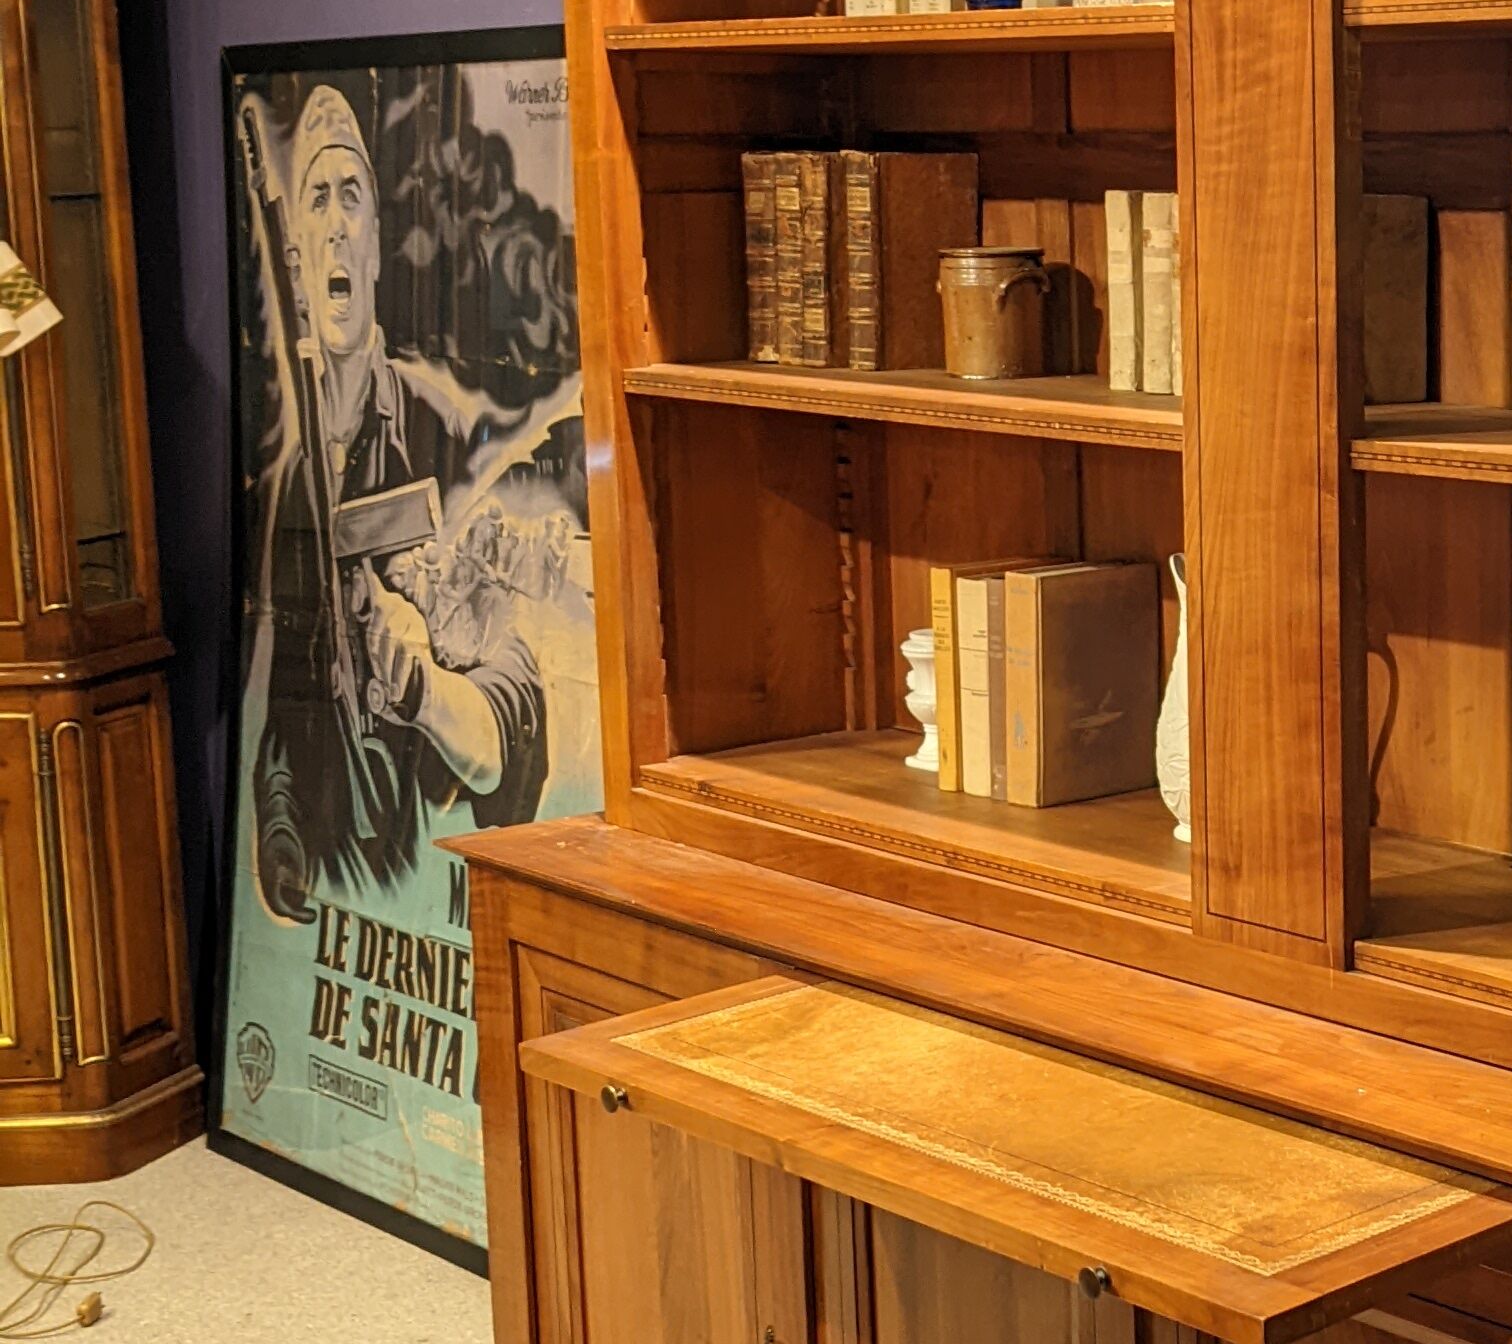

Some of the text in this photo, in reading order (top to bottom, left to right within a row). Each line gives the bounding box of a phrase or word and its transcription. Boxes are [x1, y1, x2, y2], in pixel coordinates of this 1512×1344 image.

[314, 903, 477, 1022] LE DERNIE
[309, 975, 464, 1099] DE SANTA
